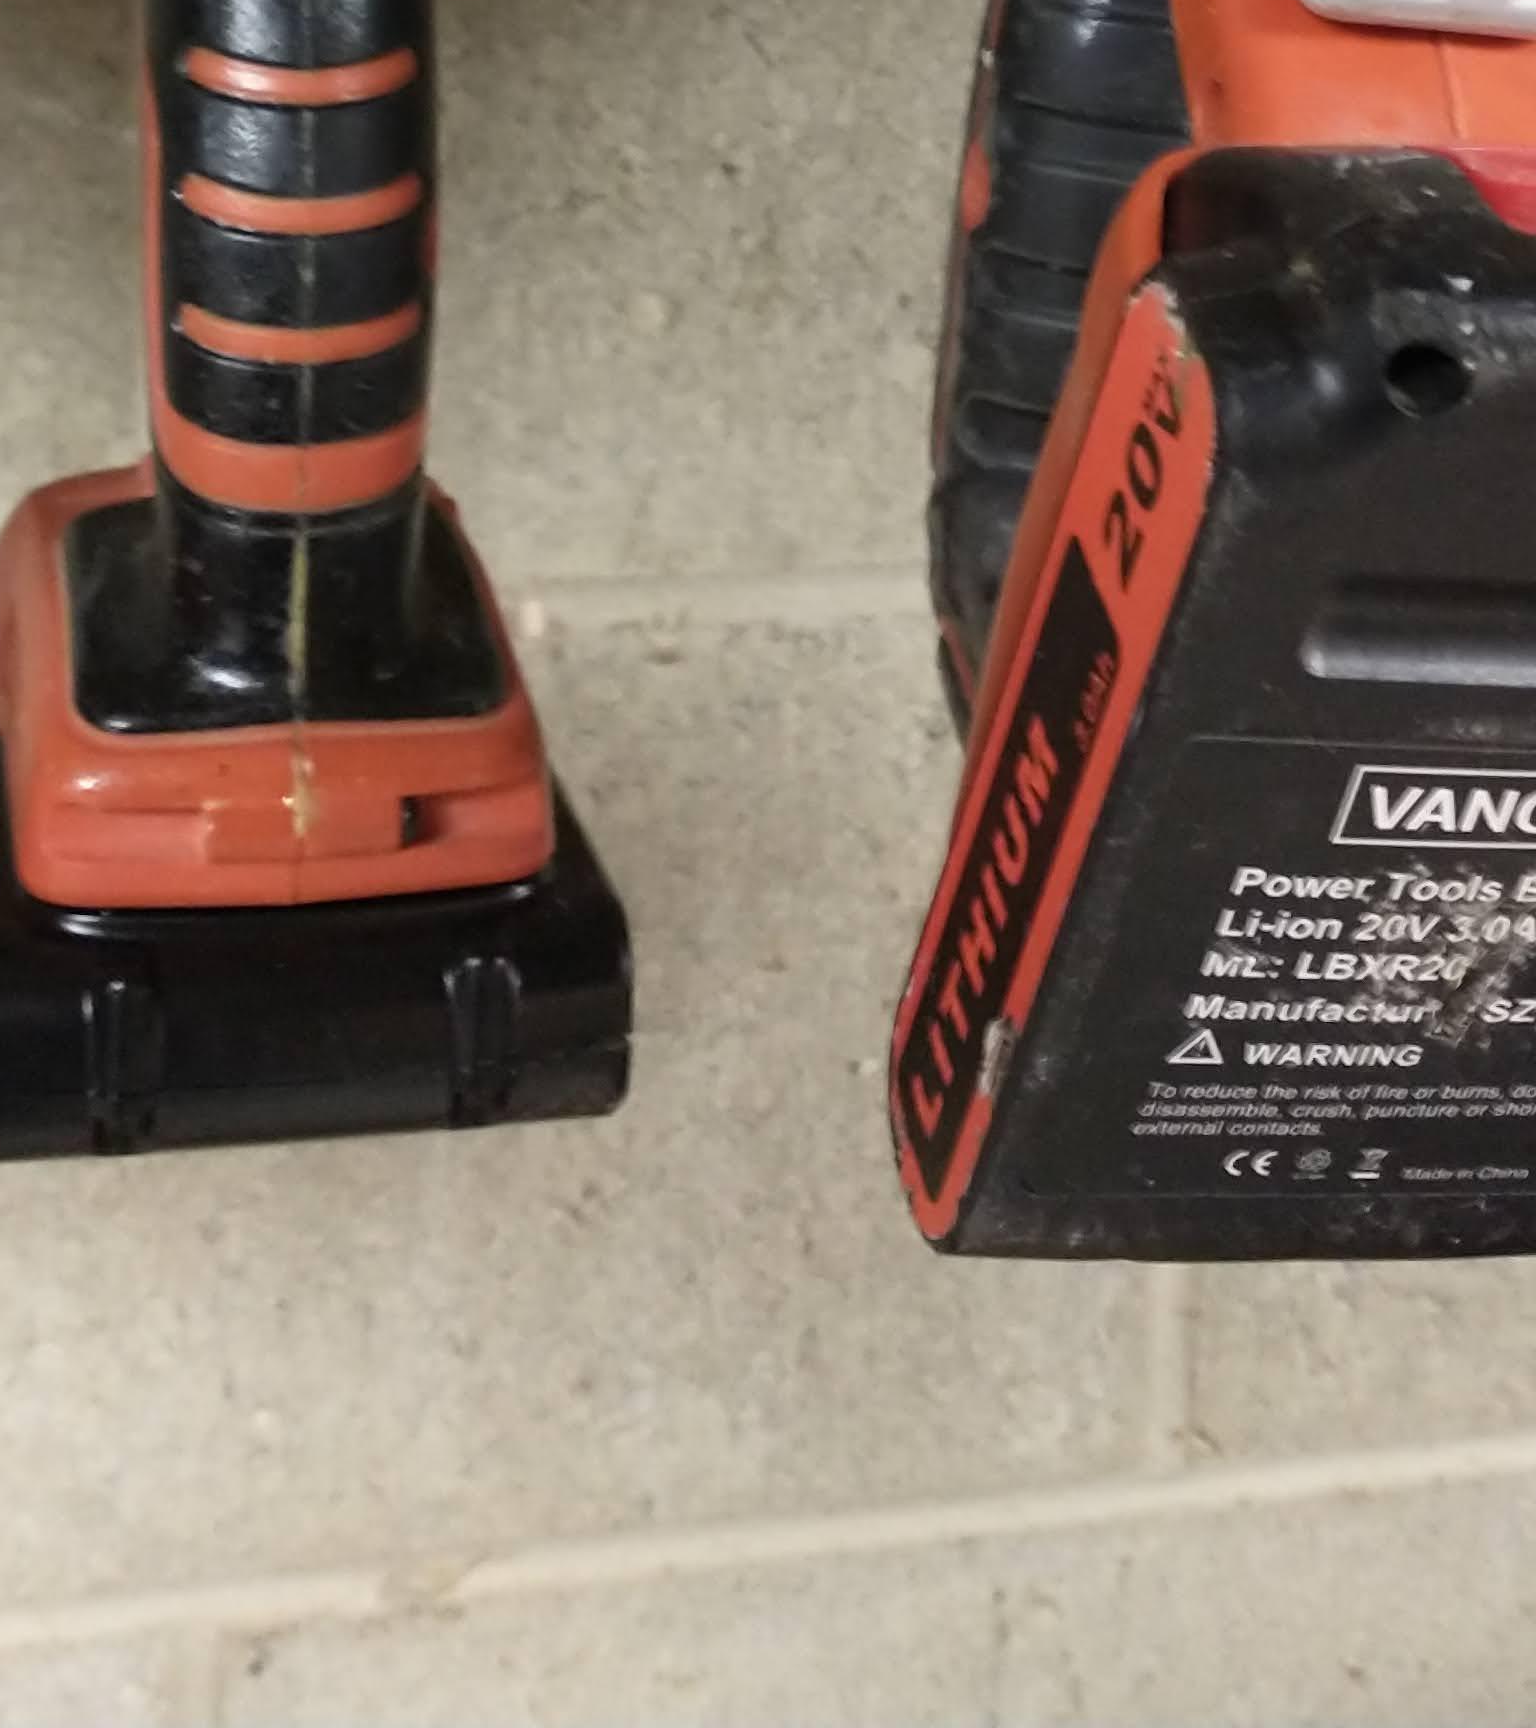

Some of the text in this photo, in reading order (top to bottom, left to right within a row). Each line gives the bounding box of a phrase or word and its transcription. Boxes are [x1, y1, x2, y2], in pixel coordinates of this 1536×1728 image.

[1228, 866, 1376, 901] Power
[1387, 872, 1504, 903] Tools
[911, 714, 1060, 1138] LITHIUM
[1215, 908, 1344, 940] Li-ion
[1351, 912, 1442, 943] 20V
[1243, 1042, 1425, 1068] WARNING
[1149, 1080, 1178, 1099] To
[1183, 1083, 1259, 1100] reduce
[1261, 1083, 1299, 1100] the
[1303, 1084, 1343, 1100] risk
[1346, 1084, 1372, 1100] of
[1374, 1084, 1409, 1100] fire
[1412, 1086, 1439, 1100] or
[1440, 1083, 1506, 1101] burns,
[1364, 1103, 1461, 1121] puncture
[1464, 1103, 1490, 1118] or
[1130, 1120, 1225, 1137] external
